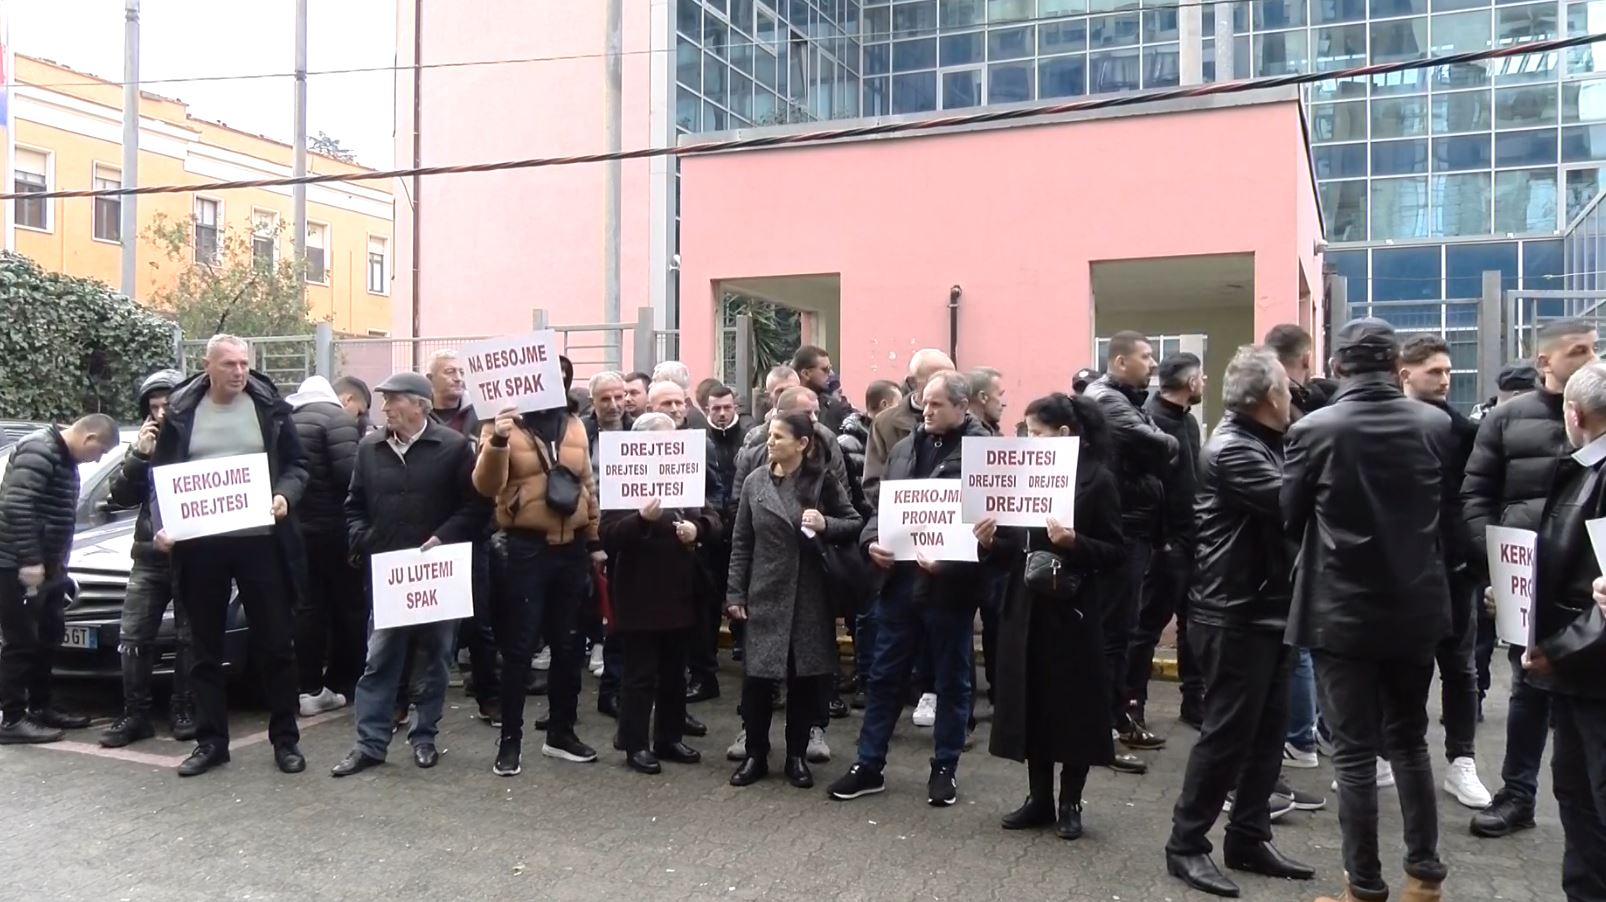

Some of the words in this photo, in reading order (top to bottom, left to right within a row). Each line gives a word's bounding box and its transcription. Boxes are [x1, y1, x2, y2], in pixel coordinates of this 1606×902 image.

[468, 355, 484, 374] NA
[485, 344, 547, 371] BESOJME
[478, 379, 502, 401] TEK
[505, 373, 544, 397] SPAK
[620, 441, 684, 456] DREJTESI
[986, 449, 1056, 466] DREJTESI
[605, 463, 648, 476] DREJTESI
[659, 462, 699, 475] DREJTESI
[172, 467, 251, 495] KERKOJME
[621, 481, 684, 497] DREJTESI
[968, 474, 1017, 488] DREJTESI
[1028, 475, 1069, 488] DREJTESI
[894, 489, 962, 504] KERKOJM
[985, 495, 1053, 513] DREJTESI
[181, 492, 248, 519] DREJTESI
[902, 510, 955, 525] PRONAT
[910, 532, 944, 546] TONA
[388, 566, 404, 586] JU
[407, 560, 453, 583] LUTEMI
[406, 589, 438, 609] SPAK
